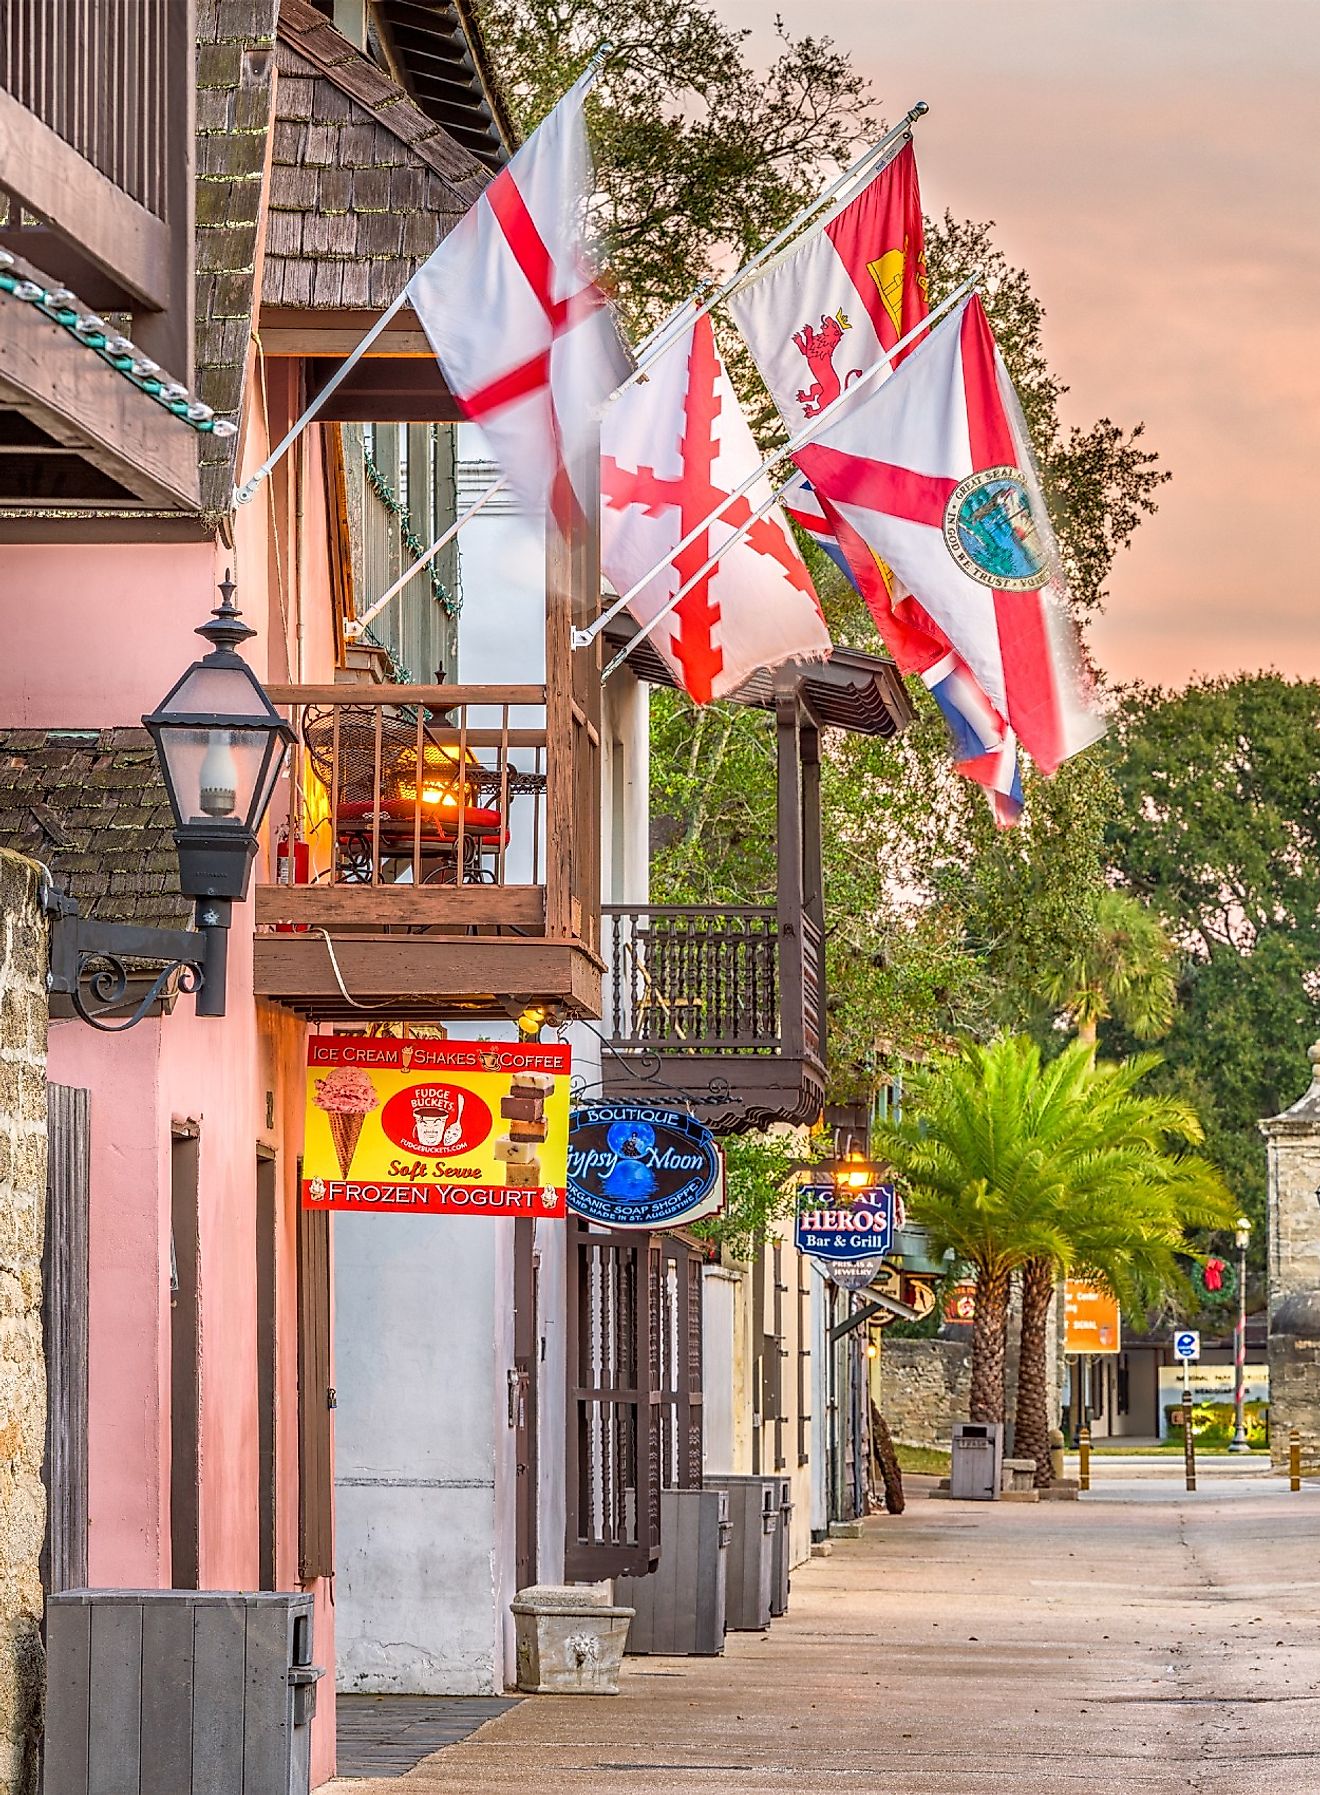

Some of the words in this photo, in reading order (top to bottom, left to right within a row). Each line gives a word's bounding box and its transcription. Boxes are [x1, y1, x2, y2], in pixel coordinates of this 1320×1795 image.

[955, 476, 983, 500] GREAT
[985, 468, 1014, 480] SEAL
[947, 512, 957, 525] IN
[947, 527, 961, 551] GOD
[957, 552, 973, 570] WE
[972, 567, 1011, 588] TRUST
[313, 1046, 337, 1061] ICE
[342, 1047, 398, 1063] CREAM
[414, 1049, 476, 1066] SHAKES
[499, 1053, 563, 1069] COFFEE
[410, 1098, 455, 1111] BUCKETS
[415, 1088, 450, 1100] FUDGE
[587, 1109, 679, 1126] BOUTIQUE
[400, 1139, 468, 1153] FUDGEBUCKETS.COM
[645, 1147, 703, 1170] Moon
[387, 1160, 428, 1181] Soft
[431, 1161, 483, 1180] Serve
[328, 1182, 430, 1204] FROZEN
[435, 1184, 537, 1208] YOGURT
[613, 1205, 649, 1215] SOAP
[651, 1182, 699, 1212] SHOPPE
[589, 1207, 616, 1220] MADE
[645, 1195, 695, 1220] AUGUSTINE
[800, 1210, 888, 1233] HEROS
[805, 1234, 831, 1247] Bar
[833, 1234, 847, 1247] &
[849, 1235, 882, 1248] Grill
[833, 1268, 872, 1276] JEWELRY
